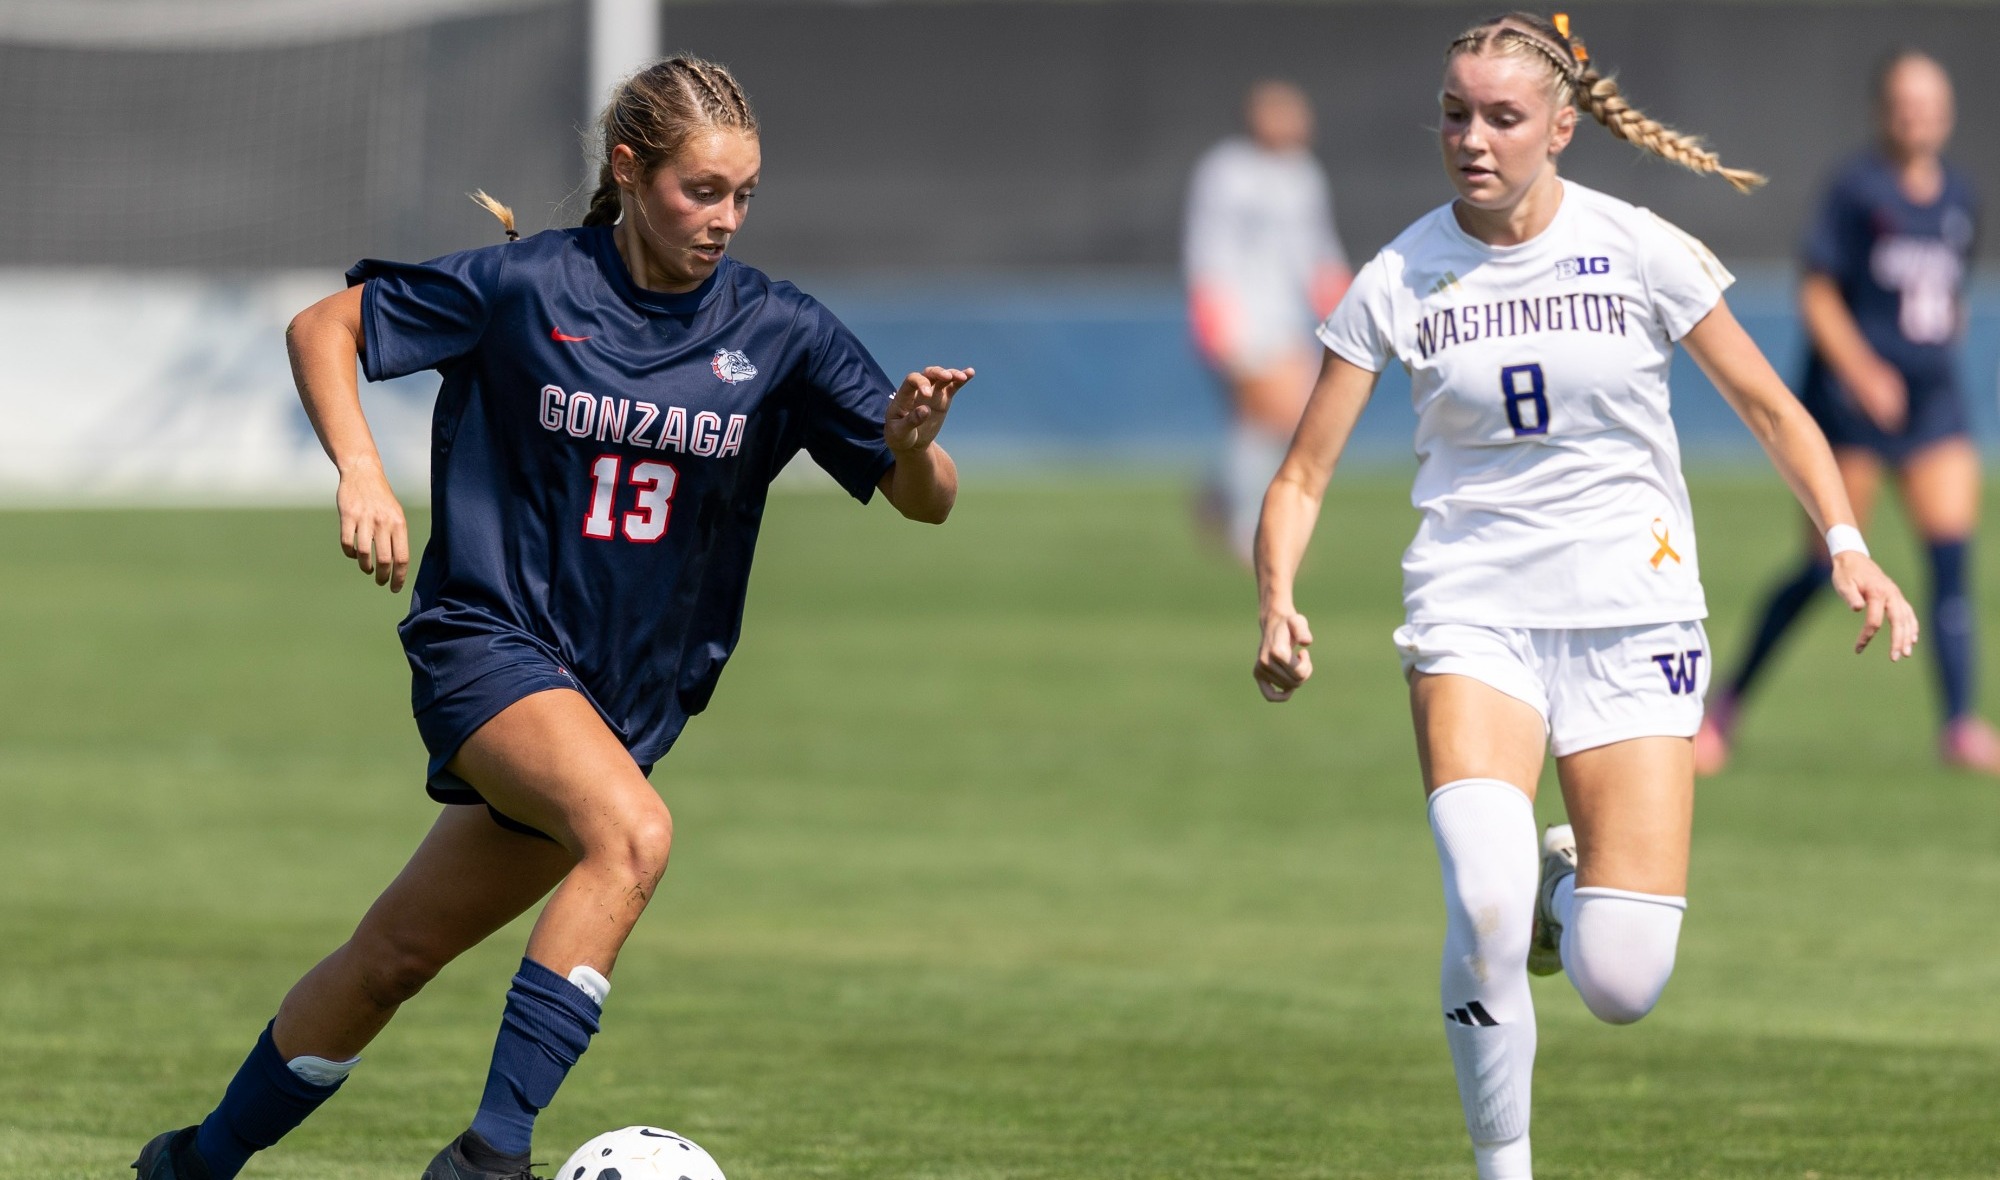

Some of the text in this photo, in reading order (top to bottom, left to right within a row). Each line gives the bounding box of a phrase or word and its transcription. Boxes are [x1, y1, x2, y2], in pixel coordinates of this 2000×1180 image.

[1415, 293, 1627, 360] WASHINGTON
[539, 384, 747, 458] GONZAGA
[1500, 363, 1550, 437] 8
[582, 454, 680, 544] 13
[1652, 650, 1702, 695] W
